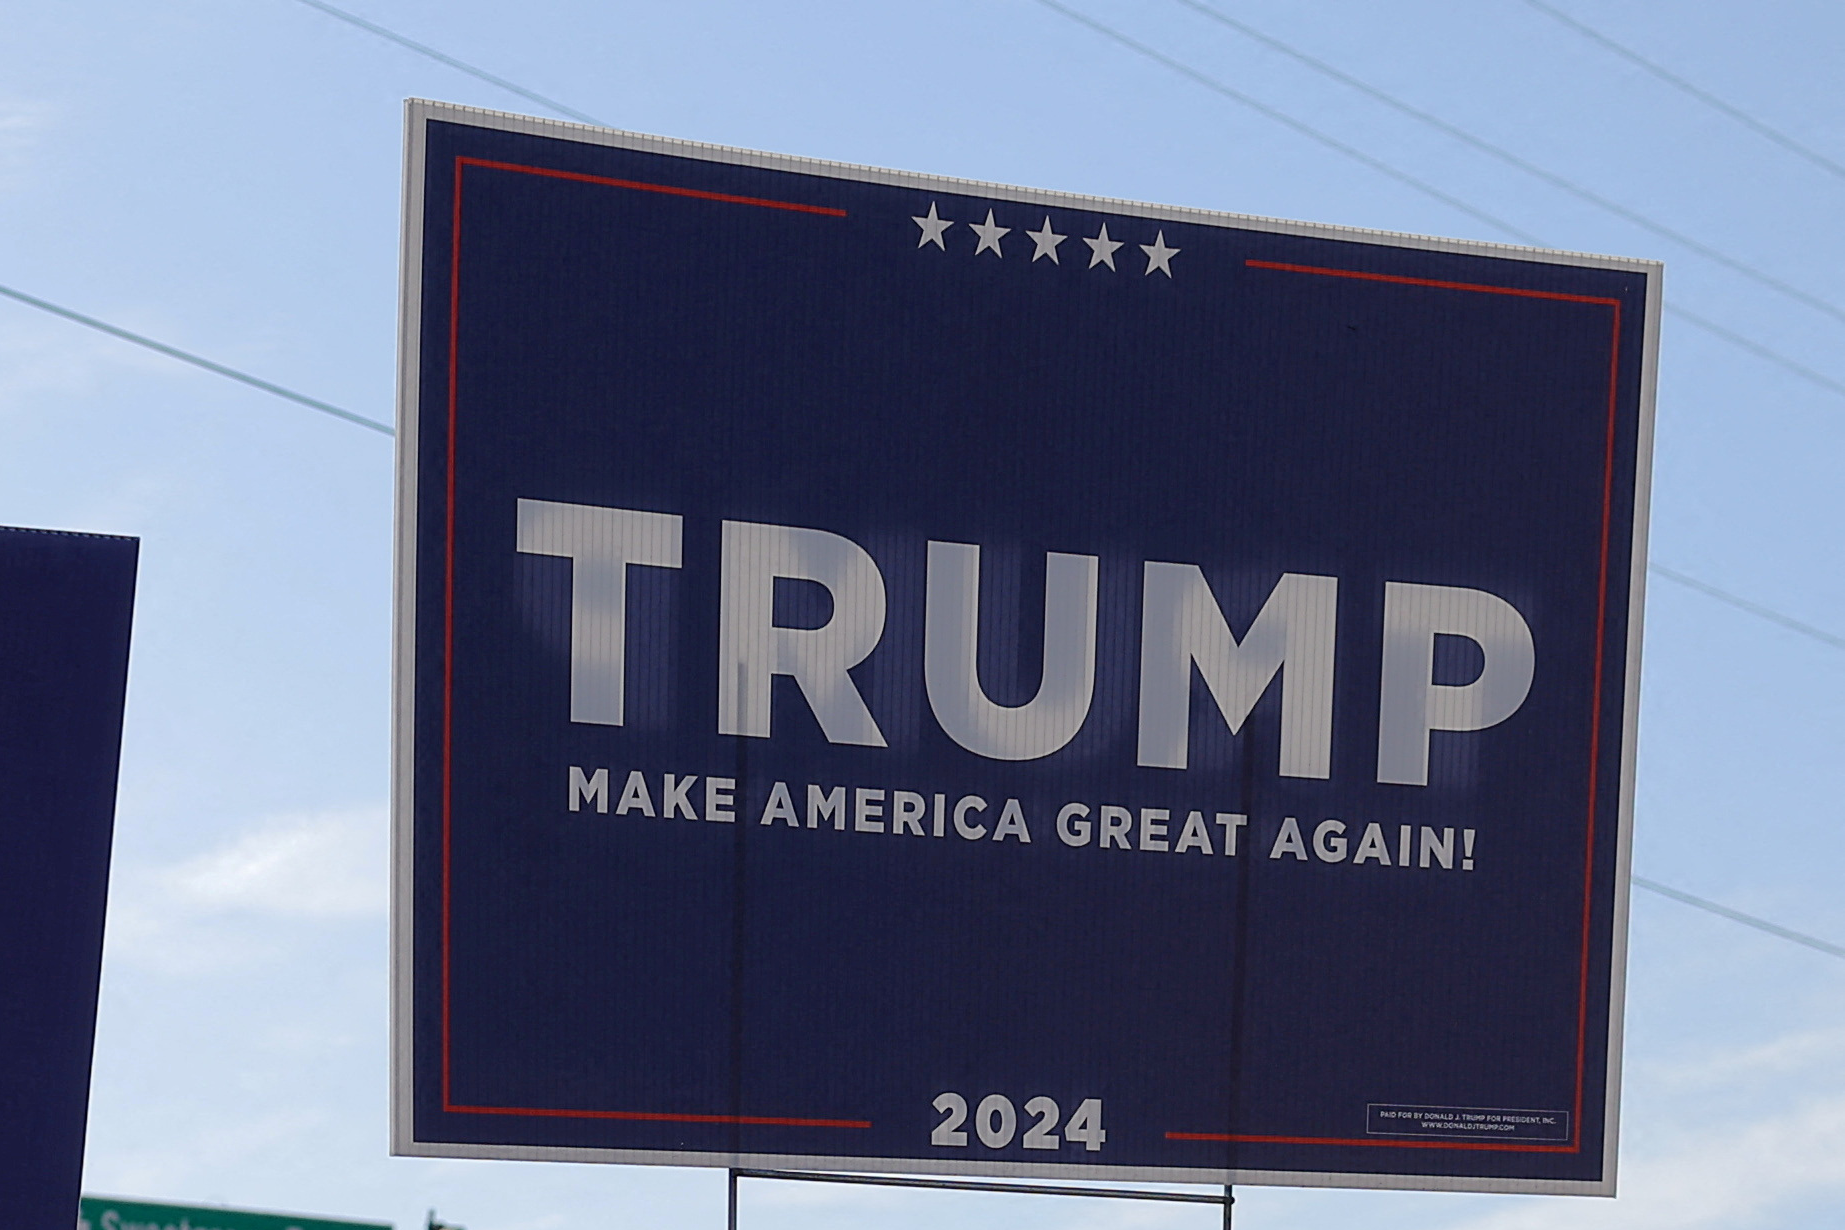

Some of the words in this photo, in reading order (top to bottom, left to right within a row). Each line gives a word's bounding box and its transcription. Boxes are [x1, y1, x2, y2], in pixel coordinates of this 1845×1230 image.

[514, 496, 1537, 788] TRUMP
[568, 765, 737, 823] MAKE
[759, 781, 1032, 844] AMERICA
[1055, 802, 1248, 857] GREAT
[1268, 816, 1477, 871] AGAIN!
[930, 1092, 1107, 1151] 2024
[1380, 1110, 1396, 1118] PAID
[1398, 1111, 1412, 1119] FOR
[1424, 1112, 1454, 1120] DONALD
